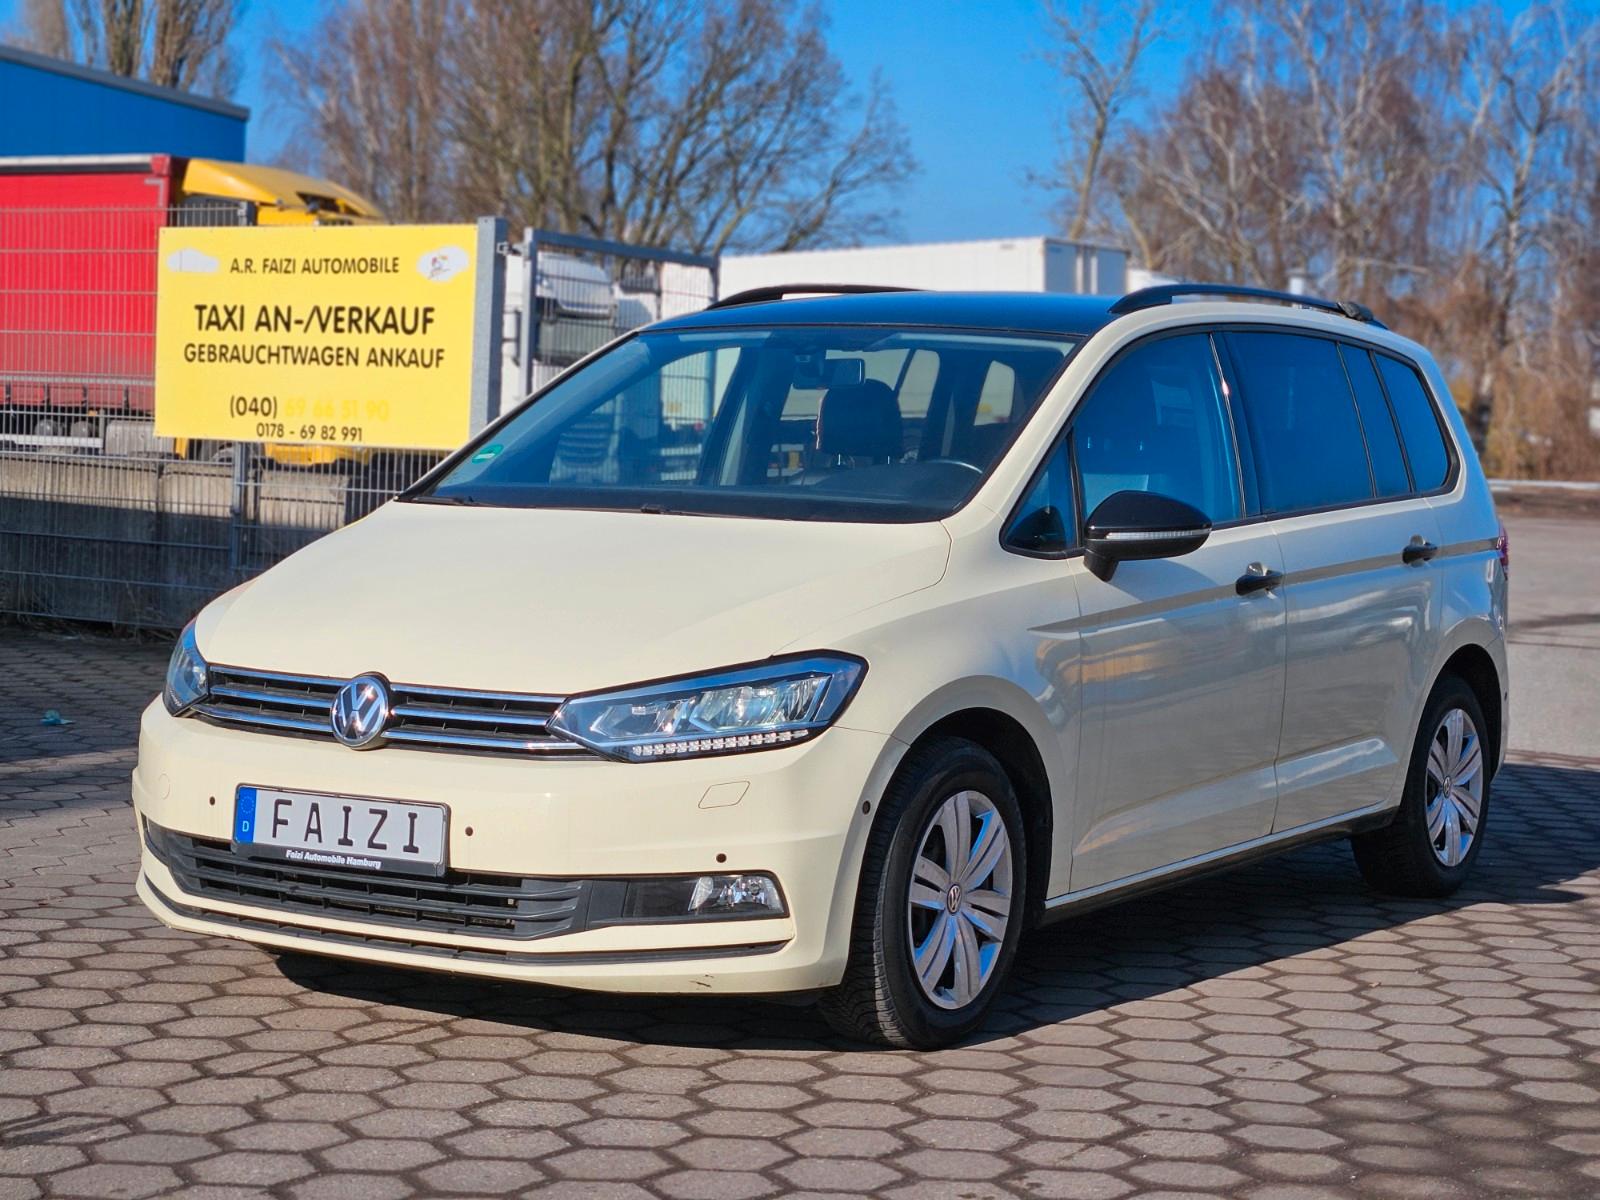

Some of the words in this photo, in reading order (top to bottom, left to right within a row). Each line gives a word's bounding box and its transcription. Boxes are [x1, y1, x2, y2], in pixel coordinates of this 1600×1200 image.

[230, 257, 257, 274] A.R.
[262, 257, 296, 275] FAIZI
[301, 256, 400, 275] AUTOMOBILE
[195, 304, 245, 332] TAXI
[255, 304, 435, 335] AN-/VERKAUF
[183, 343, 360, 367] GEBRAUCHTWAGEN
[366, 346, 445, 369] ANKAUF
[229, 395, 278, 418] (040)
[256, 423, 284, 438] 0178
[300, 424, 316, 439] 69
[320, 425, 337, 440] 82
[341, 426, 363, 442] 991
[242, 820, 250, 832] D
[286, 850, 304, 860] Faizi
[304, 852, 345, 865] Automobile
[346, 856, 382, 870] Hamburg
